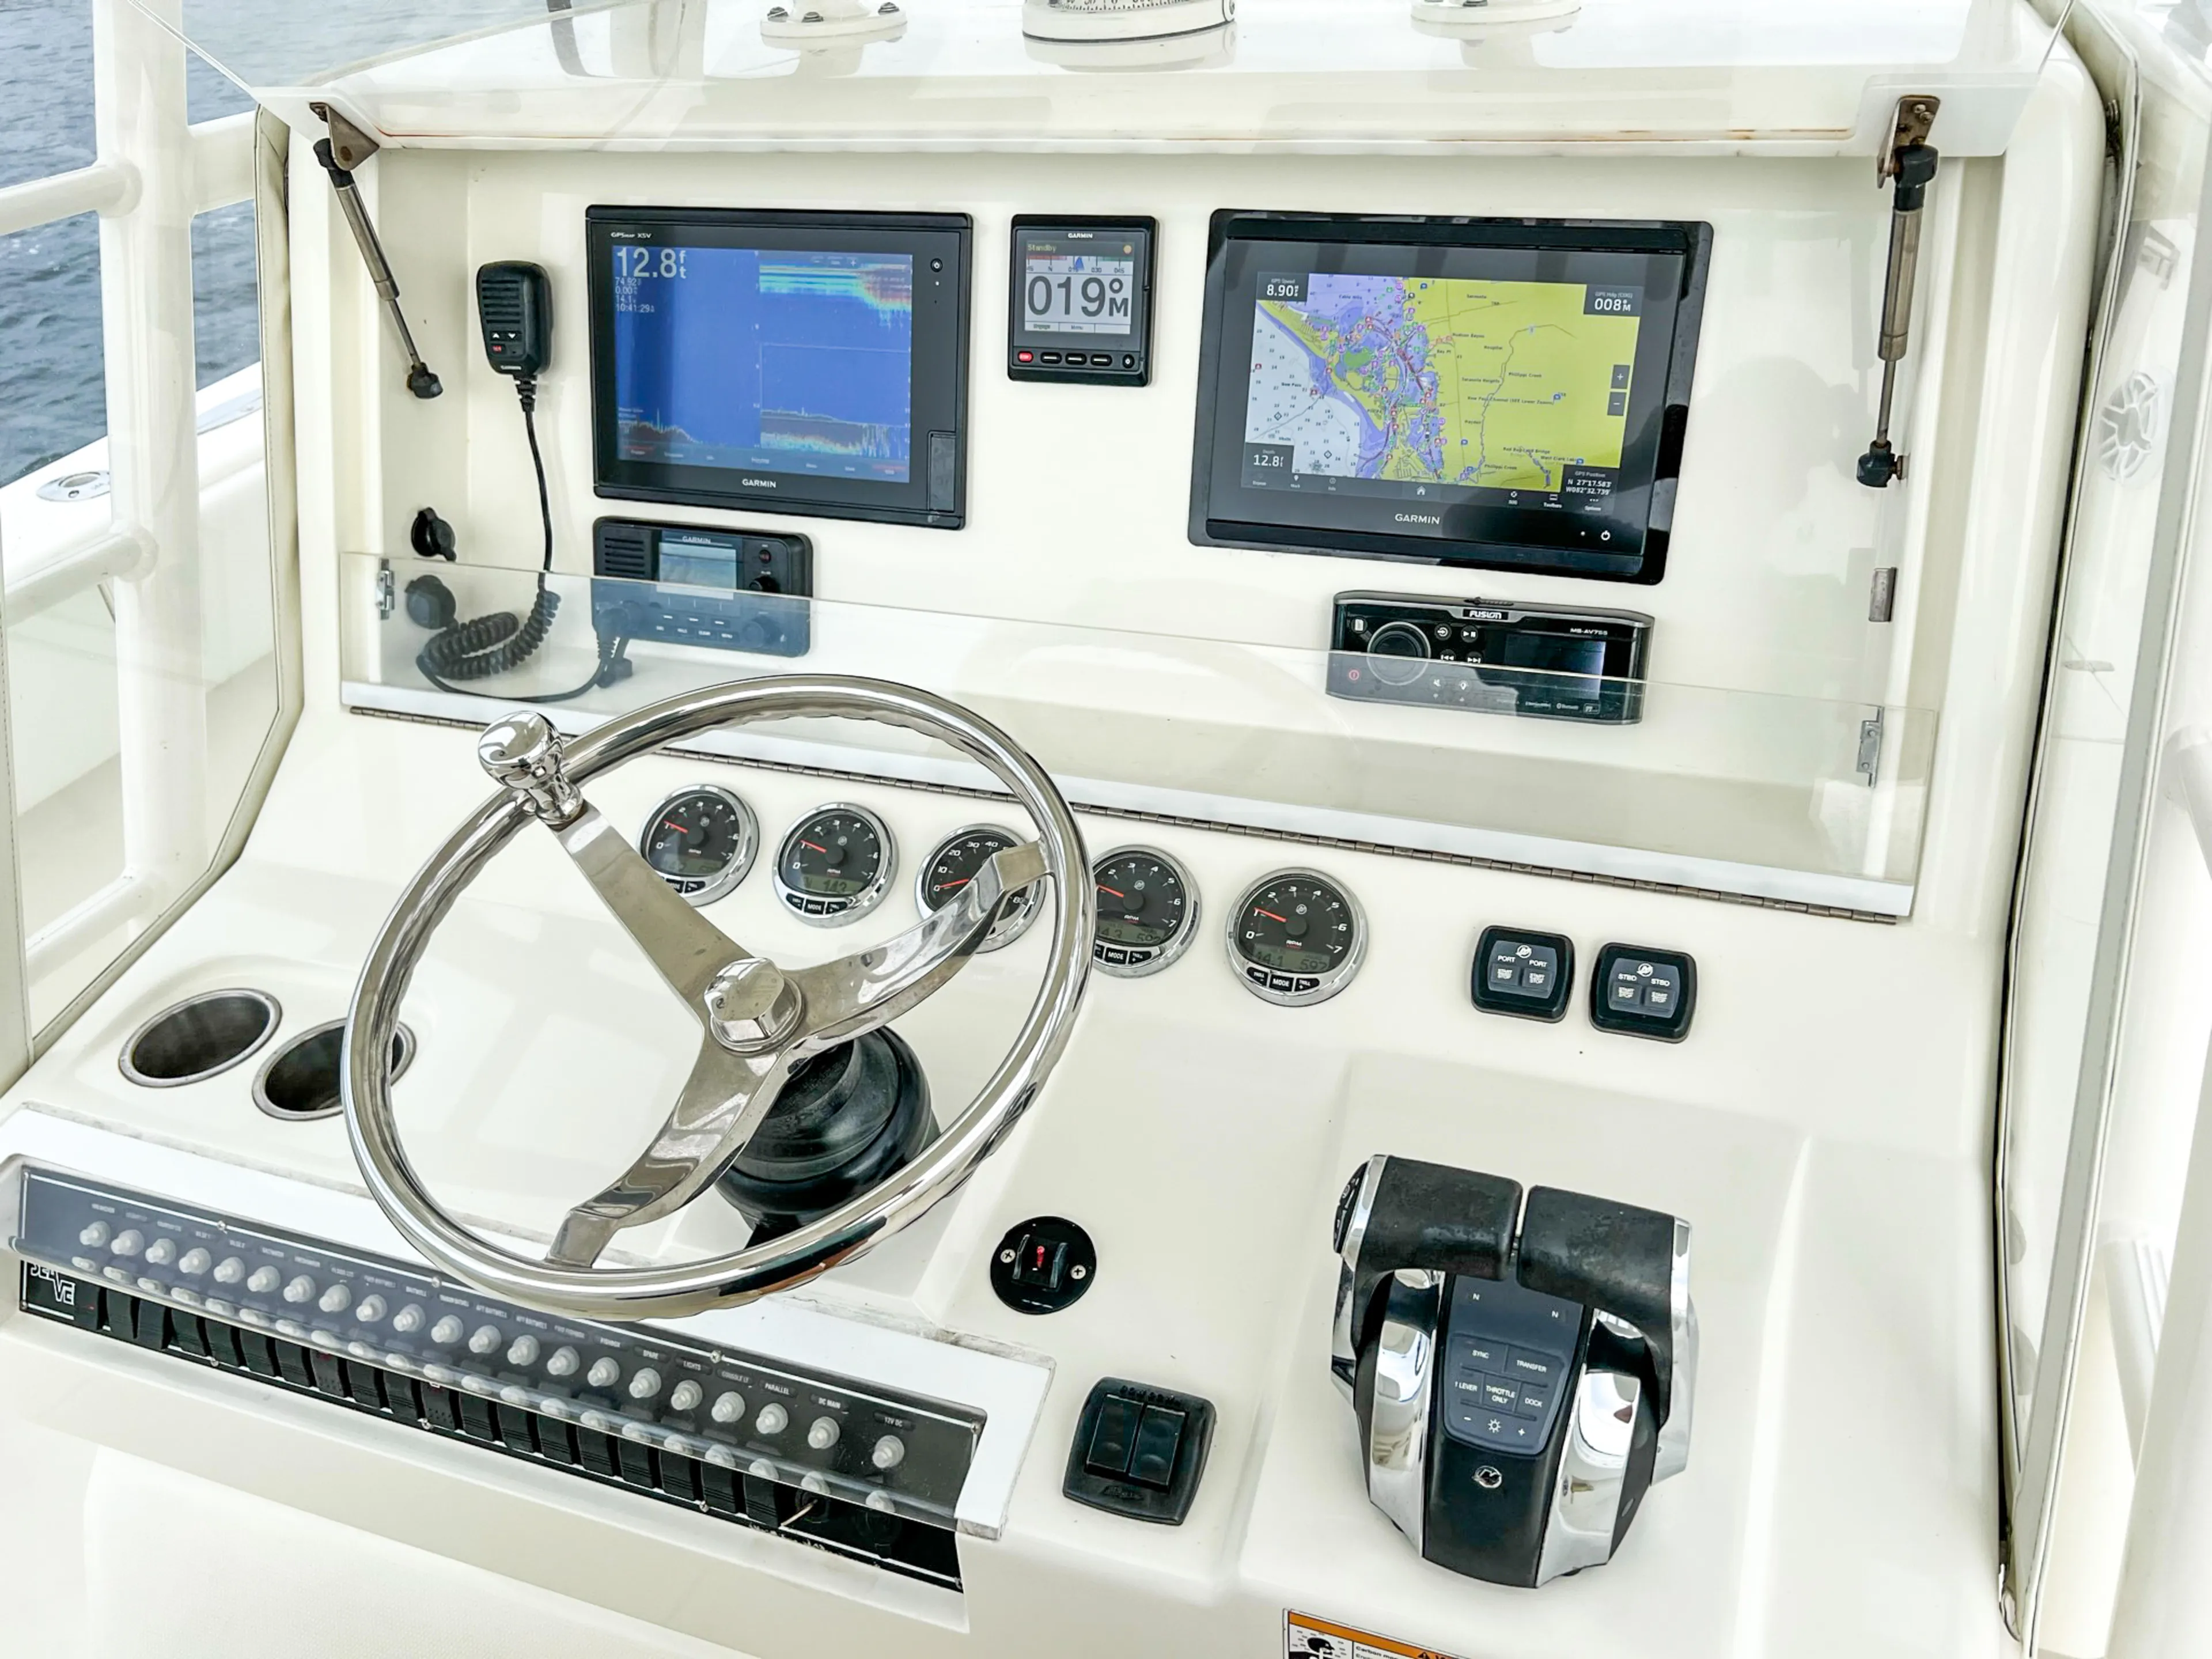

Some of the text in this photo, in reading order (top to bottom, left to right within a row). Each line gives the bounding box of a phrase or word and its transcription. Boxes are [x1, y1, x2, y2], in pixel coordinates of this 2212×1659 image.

[1028, 244, 1056, 253] Standby
[617, 247, 677, 278] 12.8
[1267, 285, 1293, 296] 8.90
[1253, 454, 1279, 467] 12.8
[742, 478, 776, 488] GARMIN
[1395, 514, 1440, 524] GARMIN
[682, 536, 711, 544] GARMIN
[1246, 931, 1255, 939] 0
[1108, 951, 1124, 960] MODE
[1498, 955, 1516, 963] PORT
[1272, 978, 1290, 987] MODE
[1618, 973, 1637, 982] STBD
[1651, 978, 1670, 987] STBD
[1472, 1350, 1489, 1359] SYNC
[1517, 1359, 1547, 1373] TRANSFER
[765, 1382, 790, 1395] PARALLEL
[1460, 1382, 1478, 1392] LEVER
[1486, 1385, 1516, 1399] THROTTLE
[826, 1399, 841, 1409] MAIN
[1492, 1395, 1508, 1404] ONLY
[1524, 1397, 1543, 1407] DOCK
[884, 1416, 903, 1427] 12V DC
[1355, 1645, 1382, 1657] Carbon
